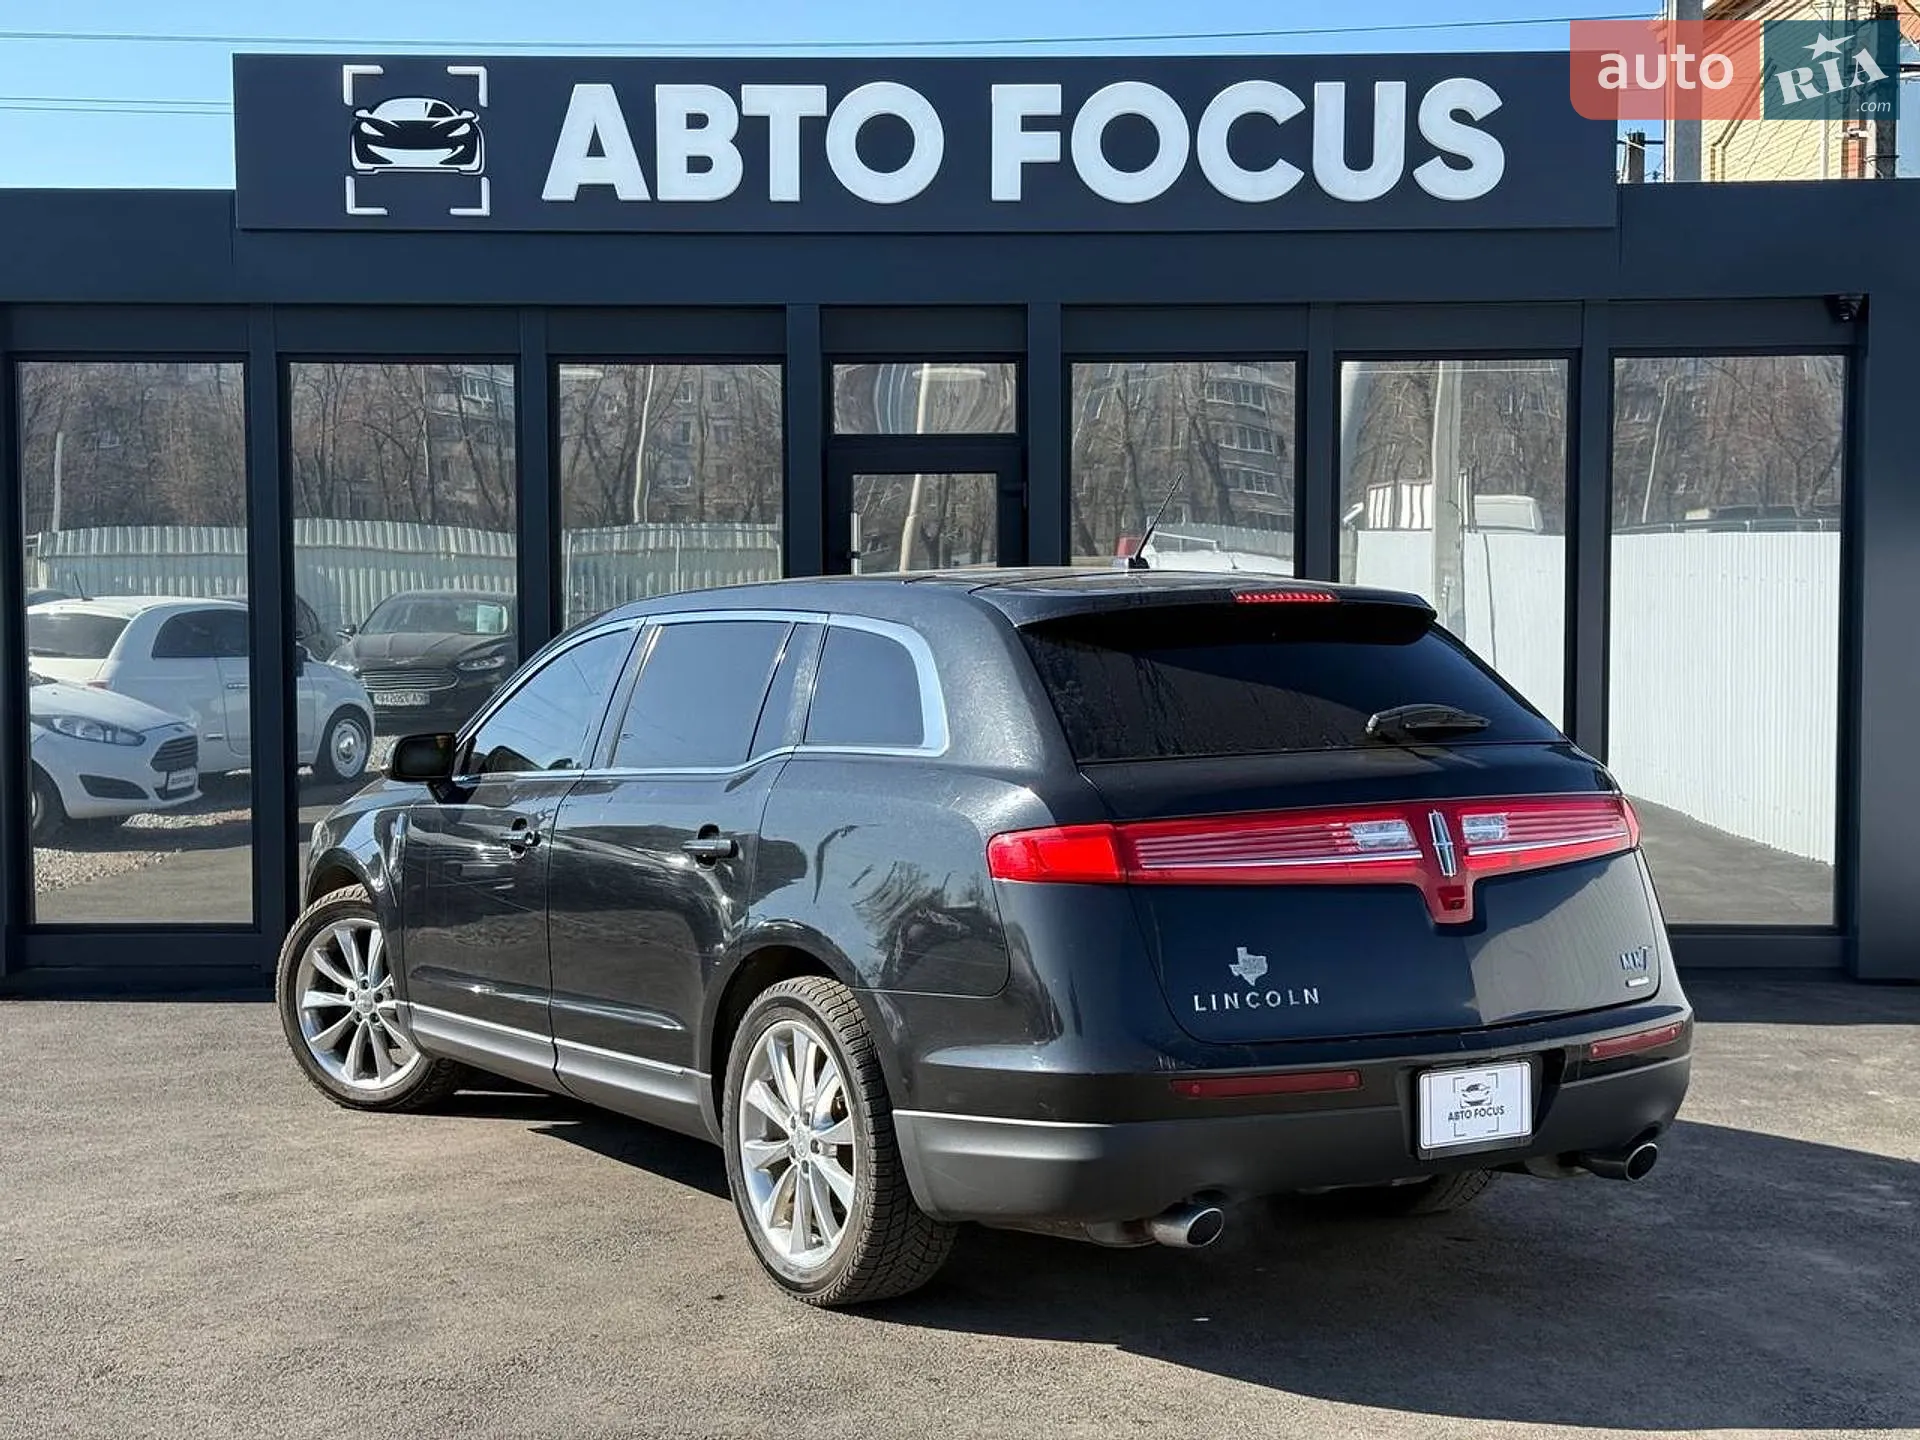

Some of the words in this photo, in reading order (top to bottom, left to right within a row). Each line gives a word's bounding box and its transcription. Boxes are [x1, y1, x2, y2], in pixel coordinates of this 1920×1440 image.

[542, 81, 945, 204] АВТО
[991, 78, 1505, 203] FOCUS
[1193, 987, 1320, 1012] LINCOLN
[1474, 1105, 1505, 1119] FOCUS
